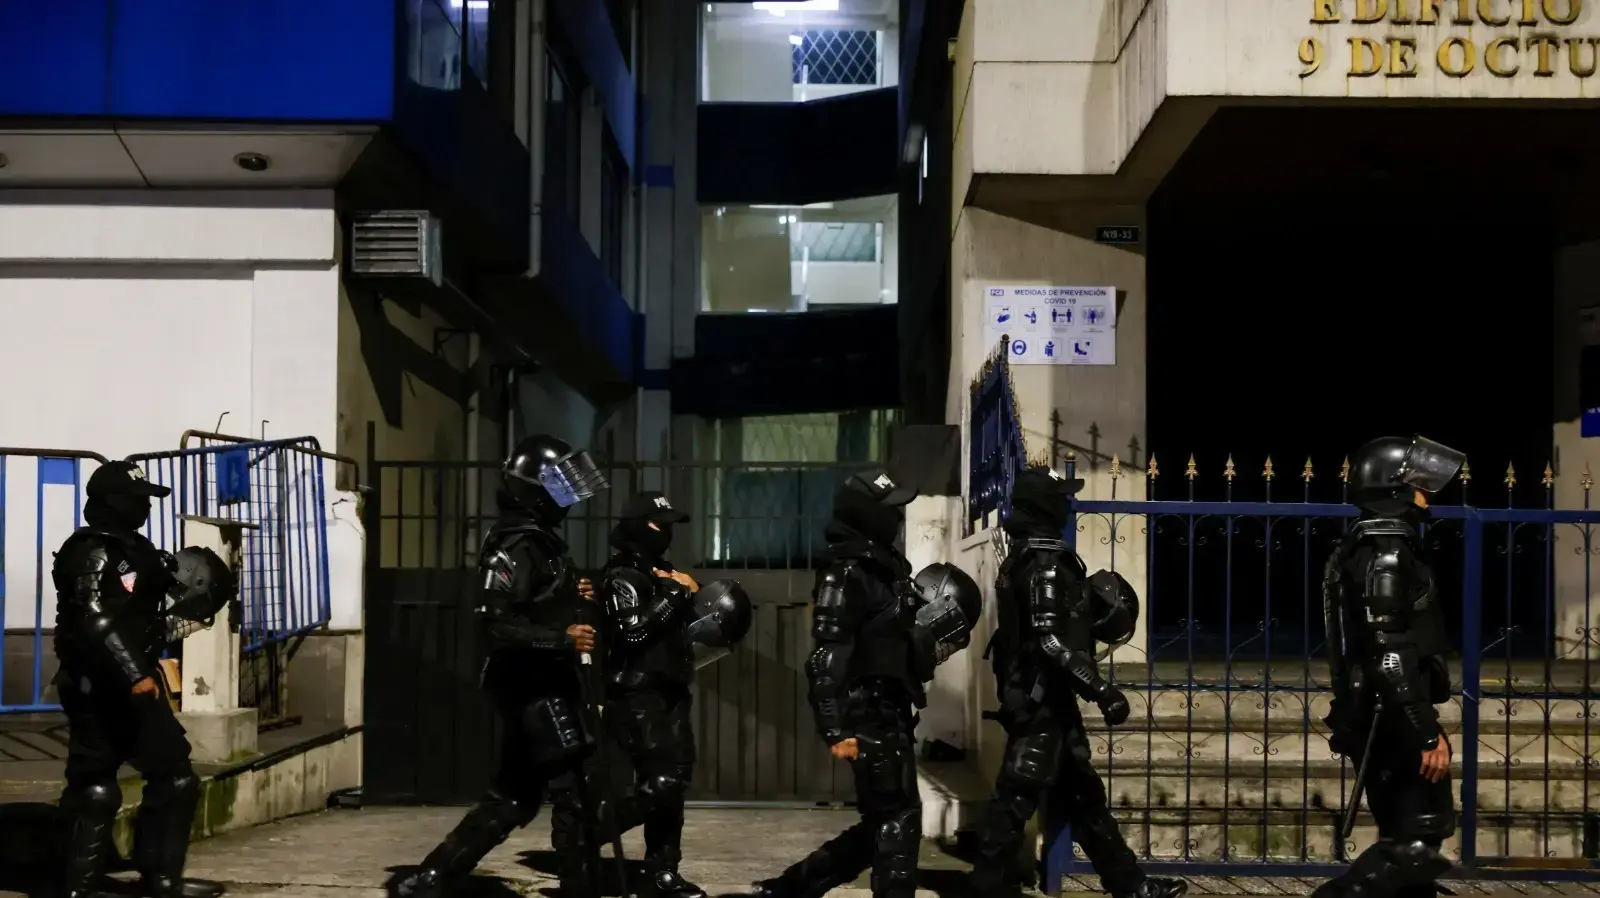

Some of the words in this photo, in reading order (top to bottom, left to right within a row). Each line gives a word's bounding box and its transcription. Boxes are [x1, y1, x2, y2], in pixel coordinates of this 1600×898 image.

[1310, 0, 1581, 27] EDIFICIO
[1298, 36, 1322, 78] 9
[1346, 37, 1417, 78] DE
[1436, 35, 1600, 78] OCTU
[1060, 288, 1106, 296] PREVENCIÓN
